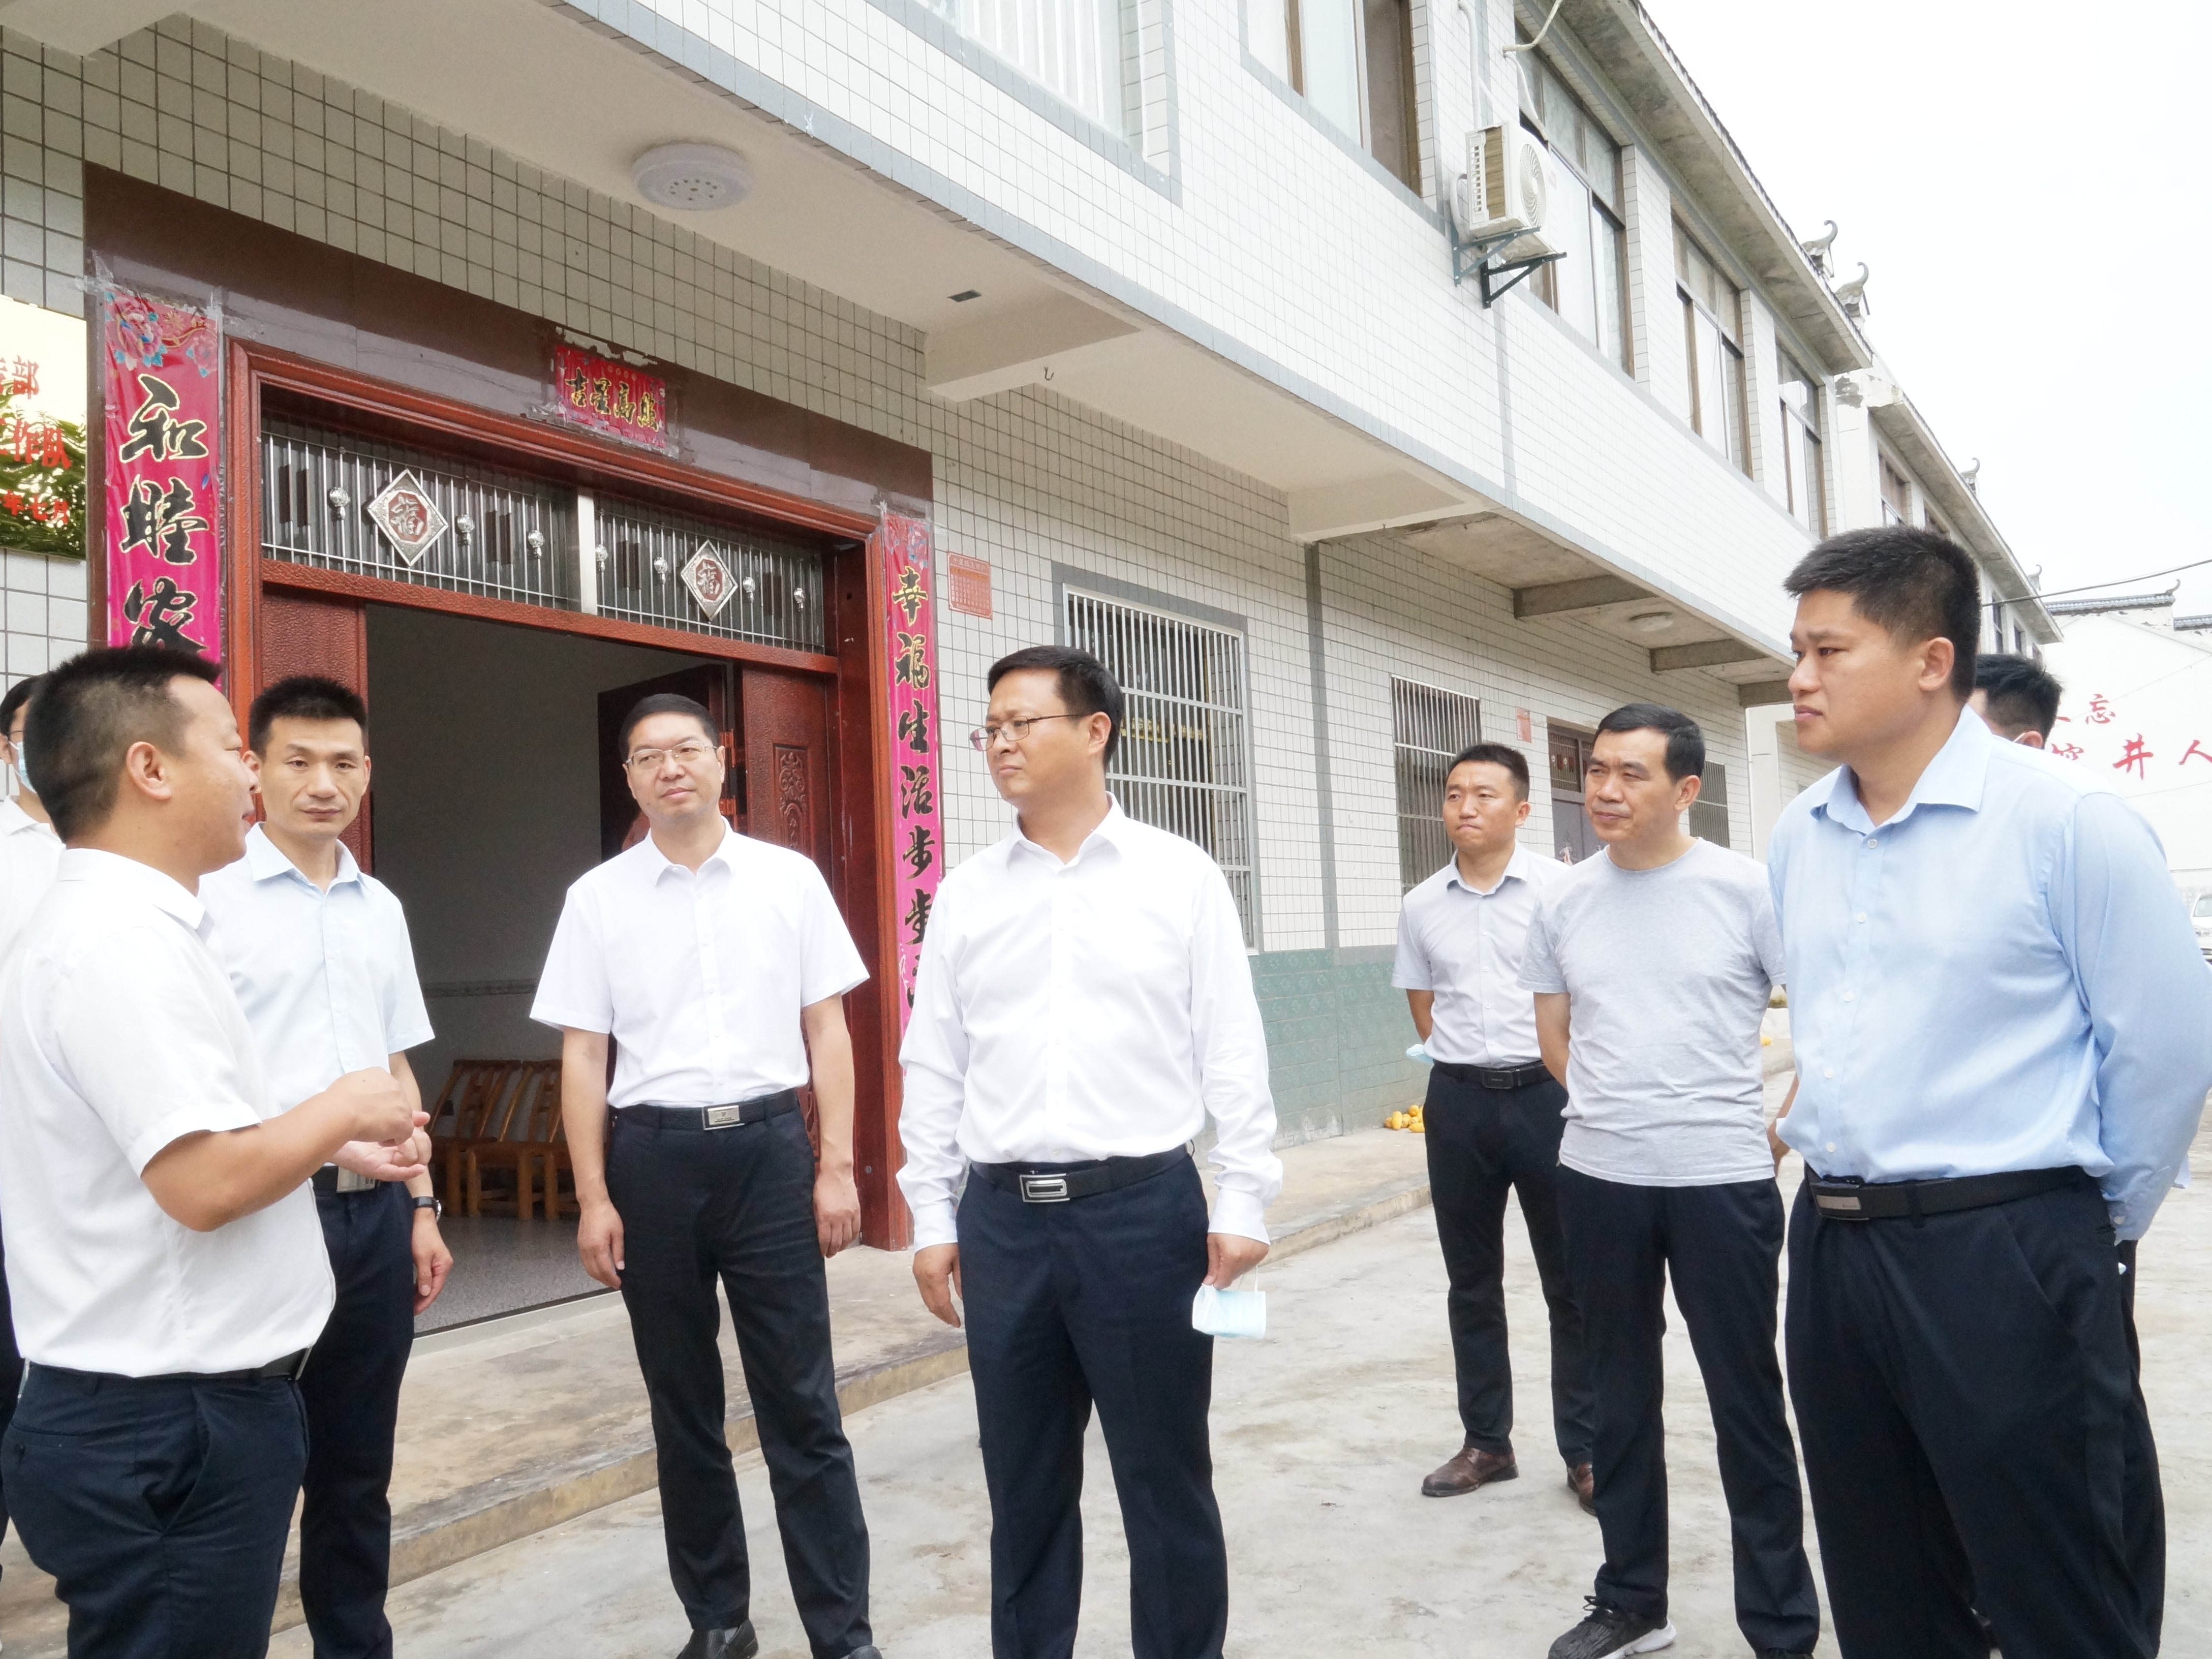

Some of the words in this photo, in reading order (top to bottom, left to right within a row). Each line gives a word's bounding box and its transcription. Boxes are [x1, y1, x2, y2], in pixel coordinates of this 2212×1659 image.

[390, 494, 424, 535] 福
[697, 560, 720, 595] 福
[2056, 693, 2115, 725] 忘
[893, 566, 935, 1008] 幸福生活步步
